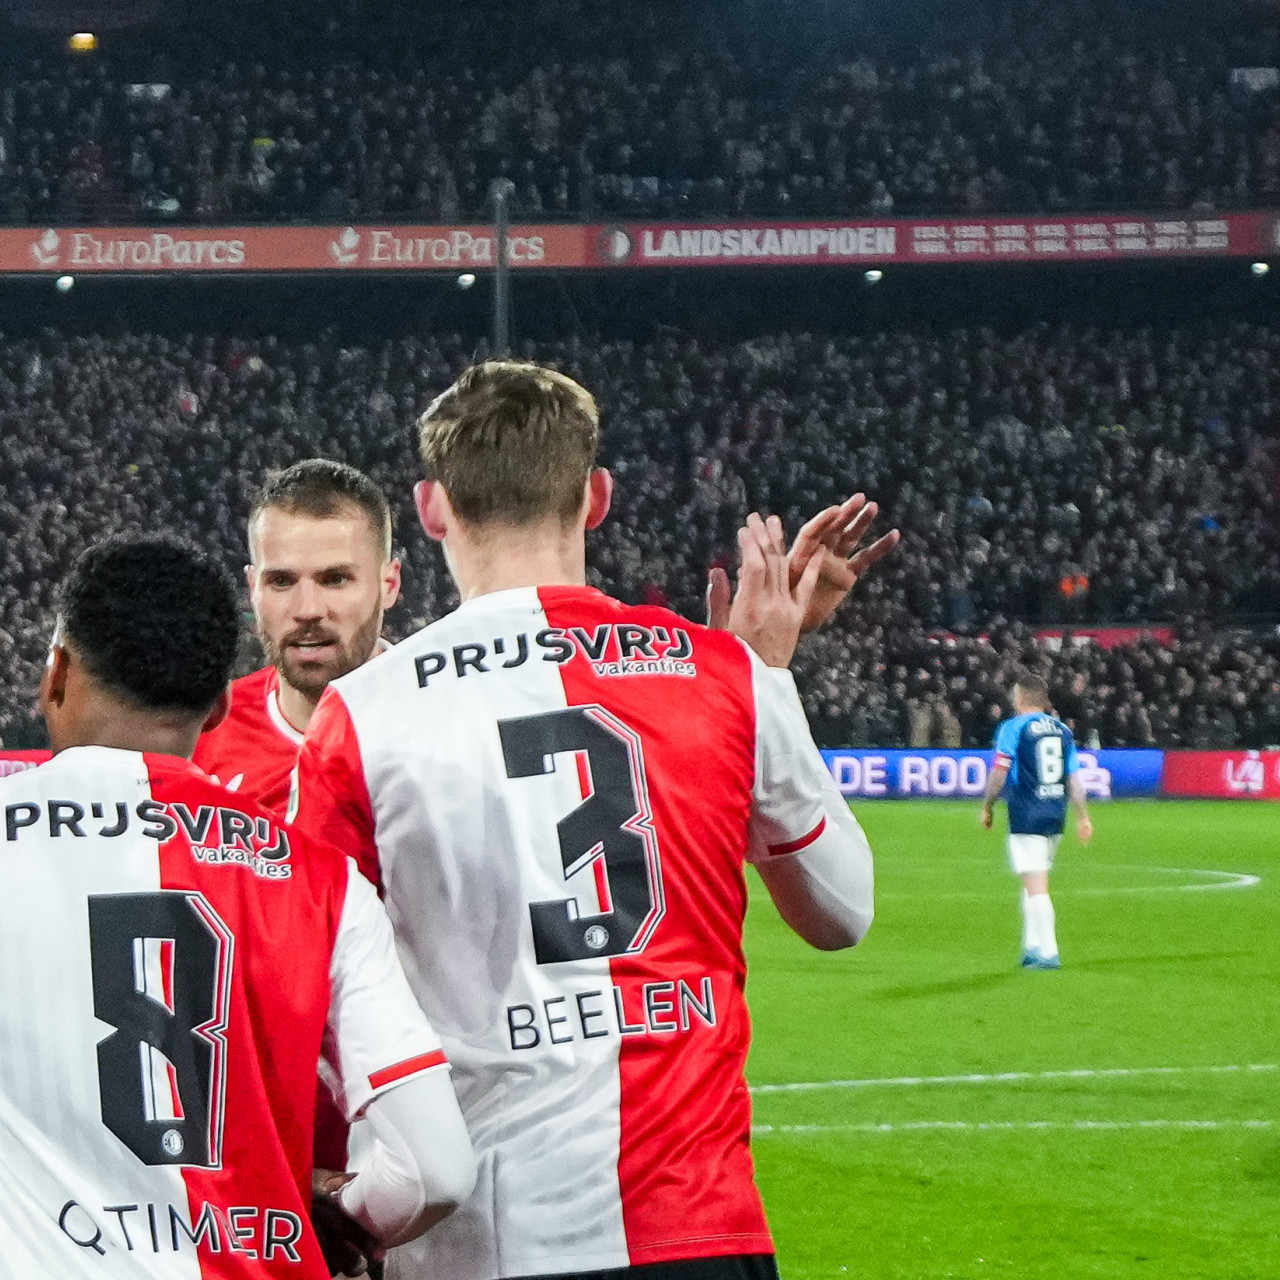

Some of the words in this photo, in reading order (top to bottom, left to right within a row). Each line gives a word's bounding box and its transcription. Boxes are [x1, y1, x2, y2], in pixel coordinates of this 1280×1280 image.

[71, 233, 245, 265] EuroParcs
[371, 230, 545, 262] EuroPacs
[643, 227, 896, 258] LANDSKAMPIOEN
[595, 657, 698, 678] vakanties
[831, 756, 887, 794] DE
[1036, 736, 1064, 785] 8
[497, 702, 667, 965] 3
[88, 889, 235, 1171] 8
[506, 976, 718, 1051] BEELEN
